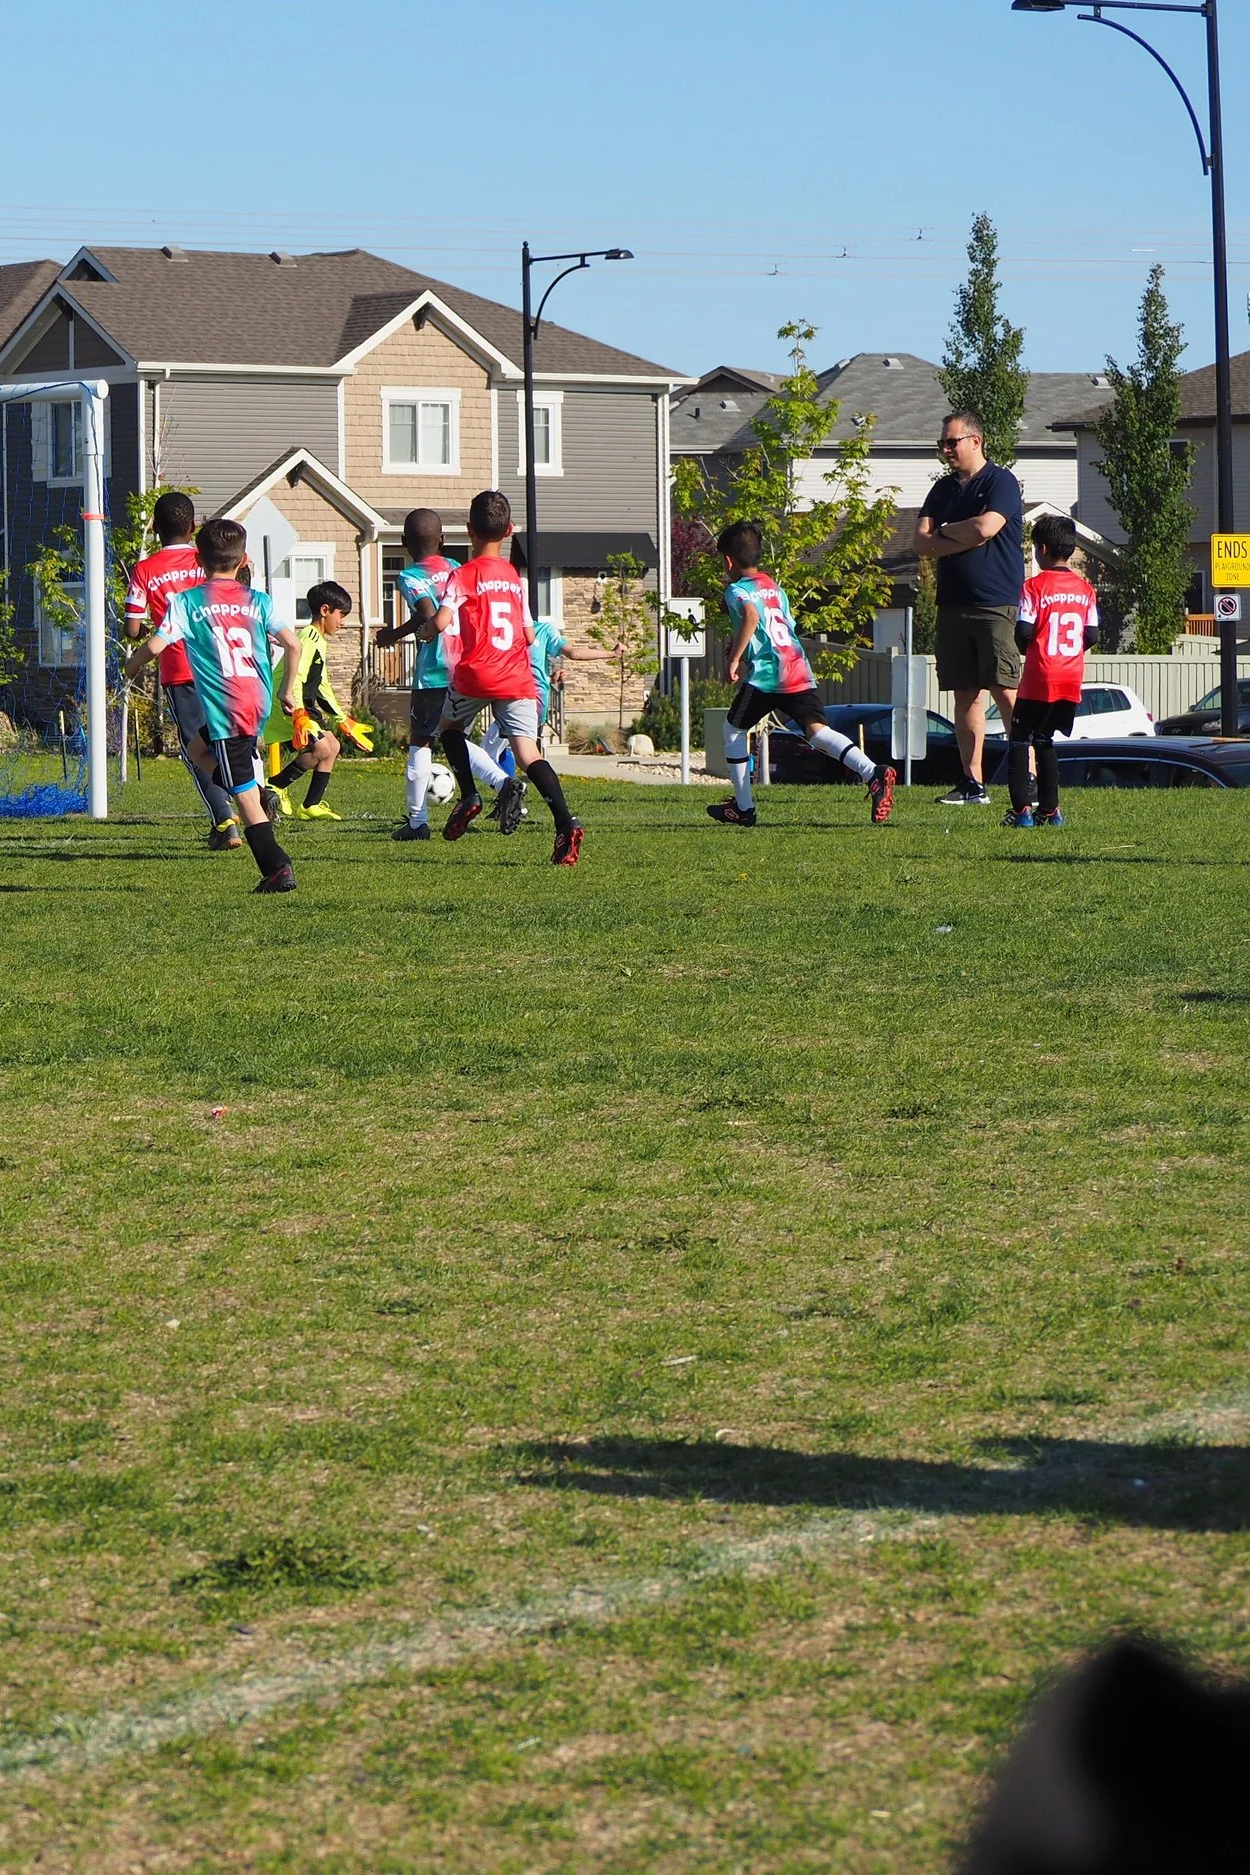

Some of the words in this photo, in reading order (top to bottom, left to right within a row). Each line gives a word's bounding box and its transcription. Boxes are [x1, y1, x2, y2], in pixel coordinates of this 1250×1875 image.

[1217, 541, 1248, 559] ENDS
[148, 567, 207, 591] Chappell
[1226, 572, 1240, 581] ZONE
[1040, 593, 1089, 609] Chappell
[490, 601, 514, 651] 5
[764, 606, 792, 647] 16
[1048, 612, 1084, 657] 13
[212, 625, 258, 678] 12
